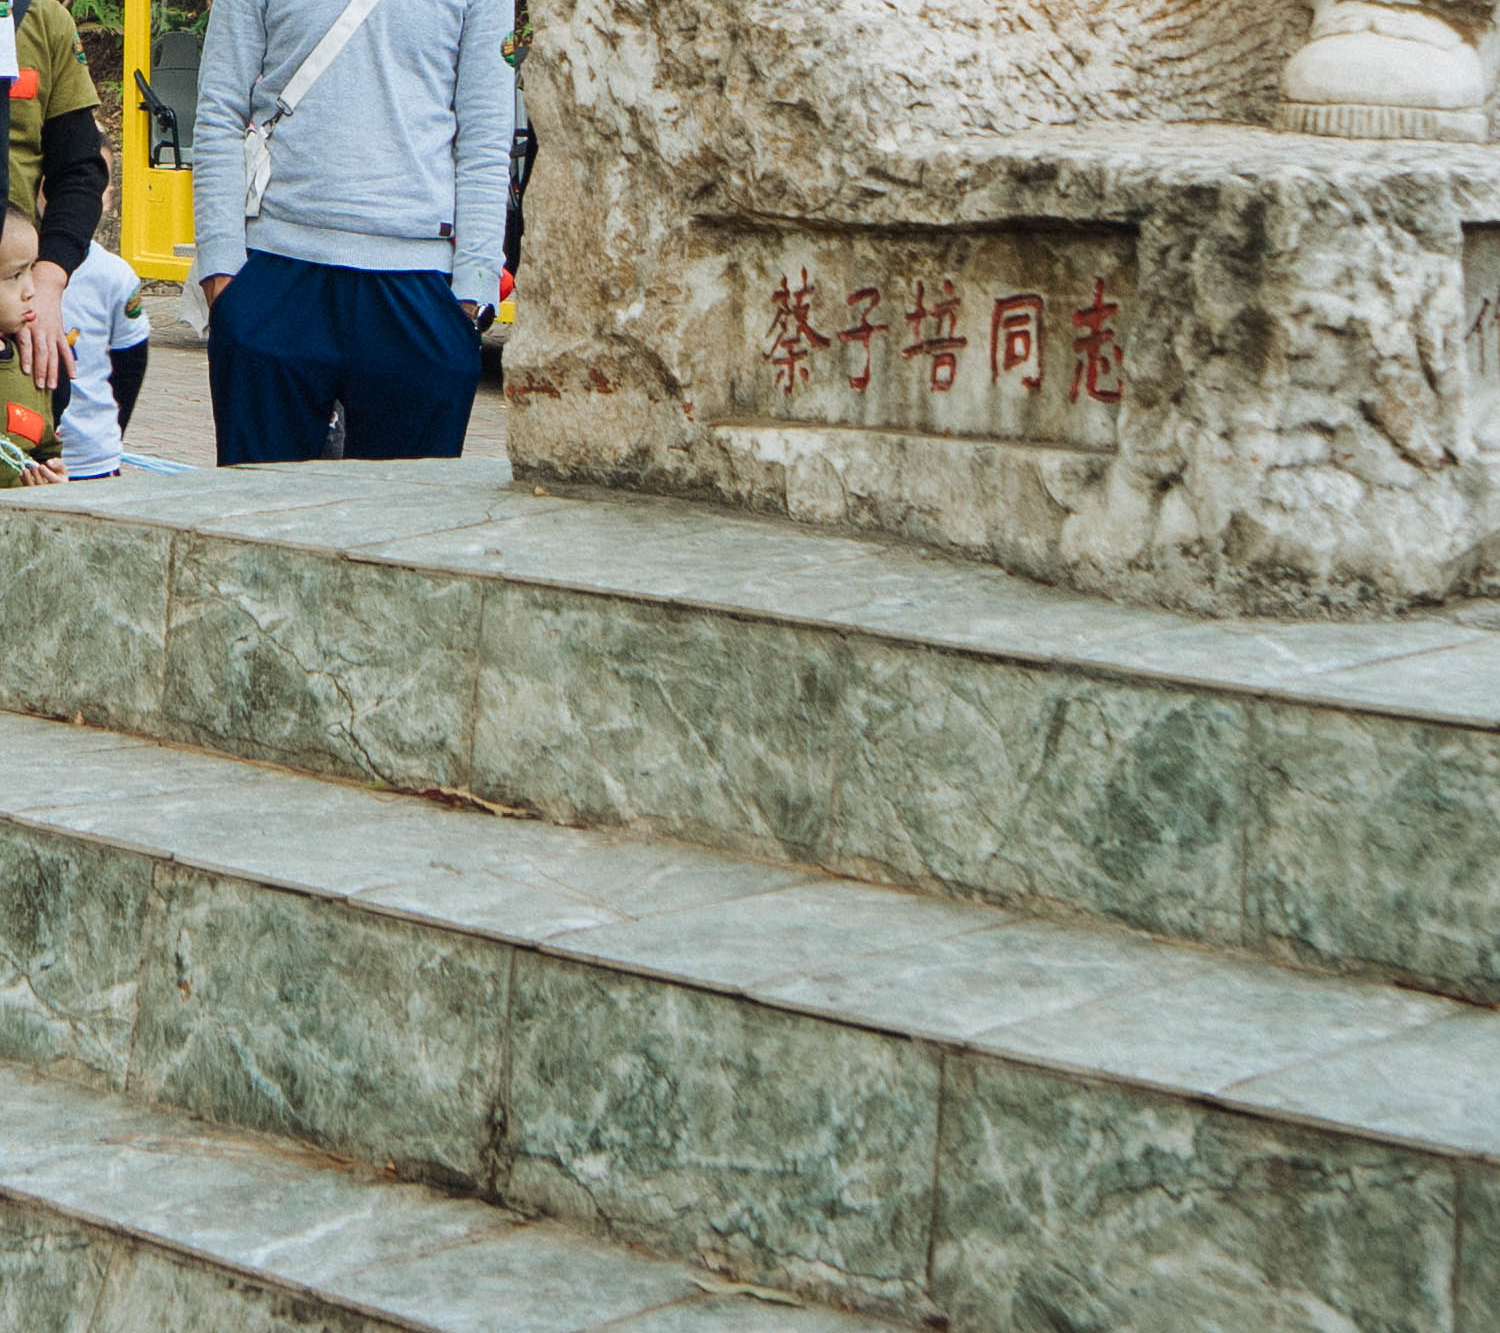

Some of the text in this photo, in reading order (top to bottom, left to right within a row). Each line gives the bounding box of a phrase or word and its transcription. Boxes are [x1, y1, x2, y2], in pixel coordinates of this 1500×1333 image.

[763, 265, 1124, 404] 蔡子培同志
